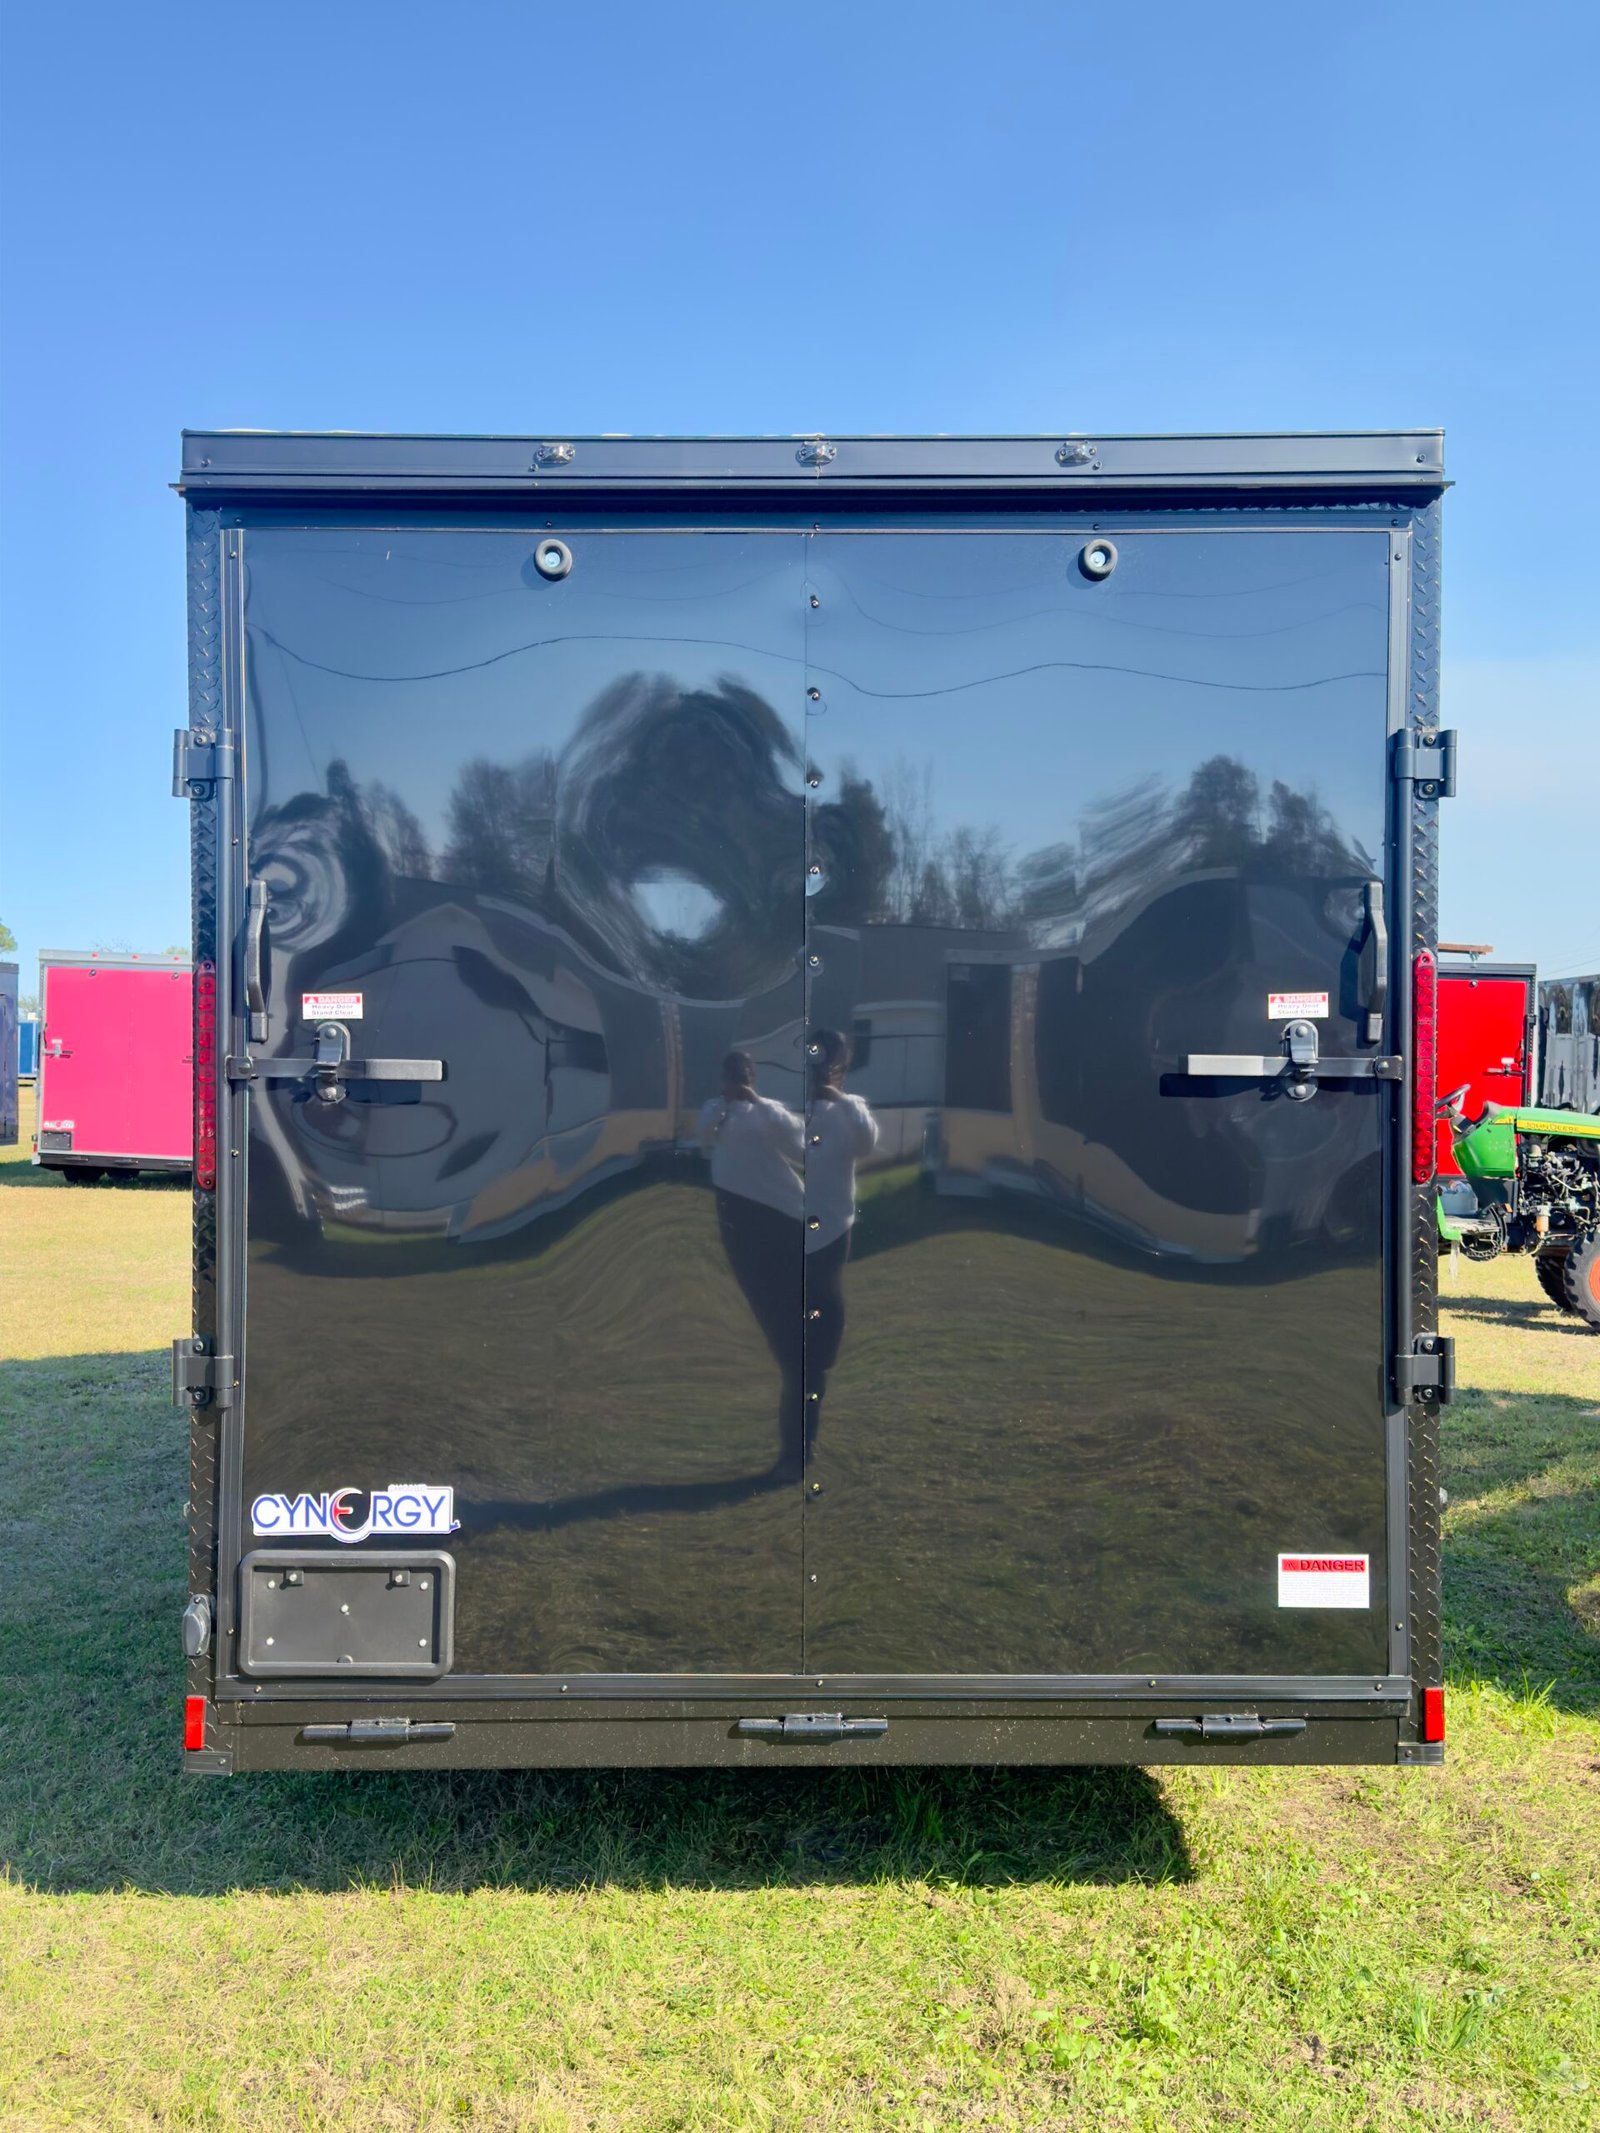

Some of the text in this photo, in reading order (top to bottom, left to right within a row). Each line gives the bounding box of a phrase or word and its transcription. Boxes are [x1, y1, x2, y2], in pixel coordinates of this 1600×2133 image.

[318, 996, 357, 1004] DANGER
[253, 1489, 446, 1534] CYNERGY
[1300, 1559, 1365, 1572] DANGER
